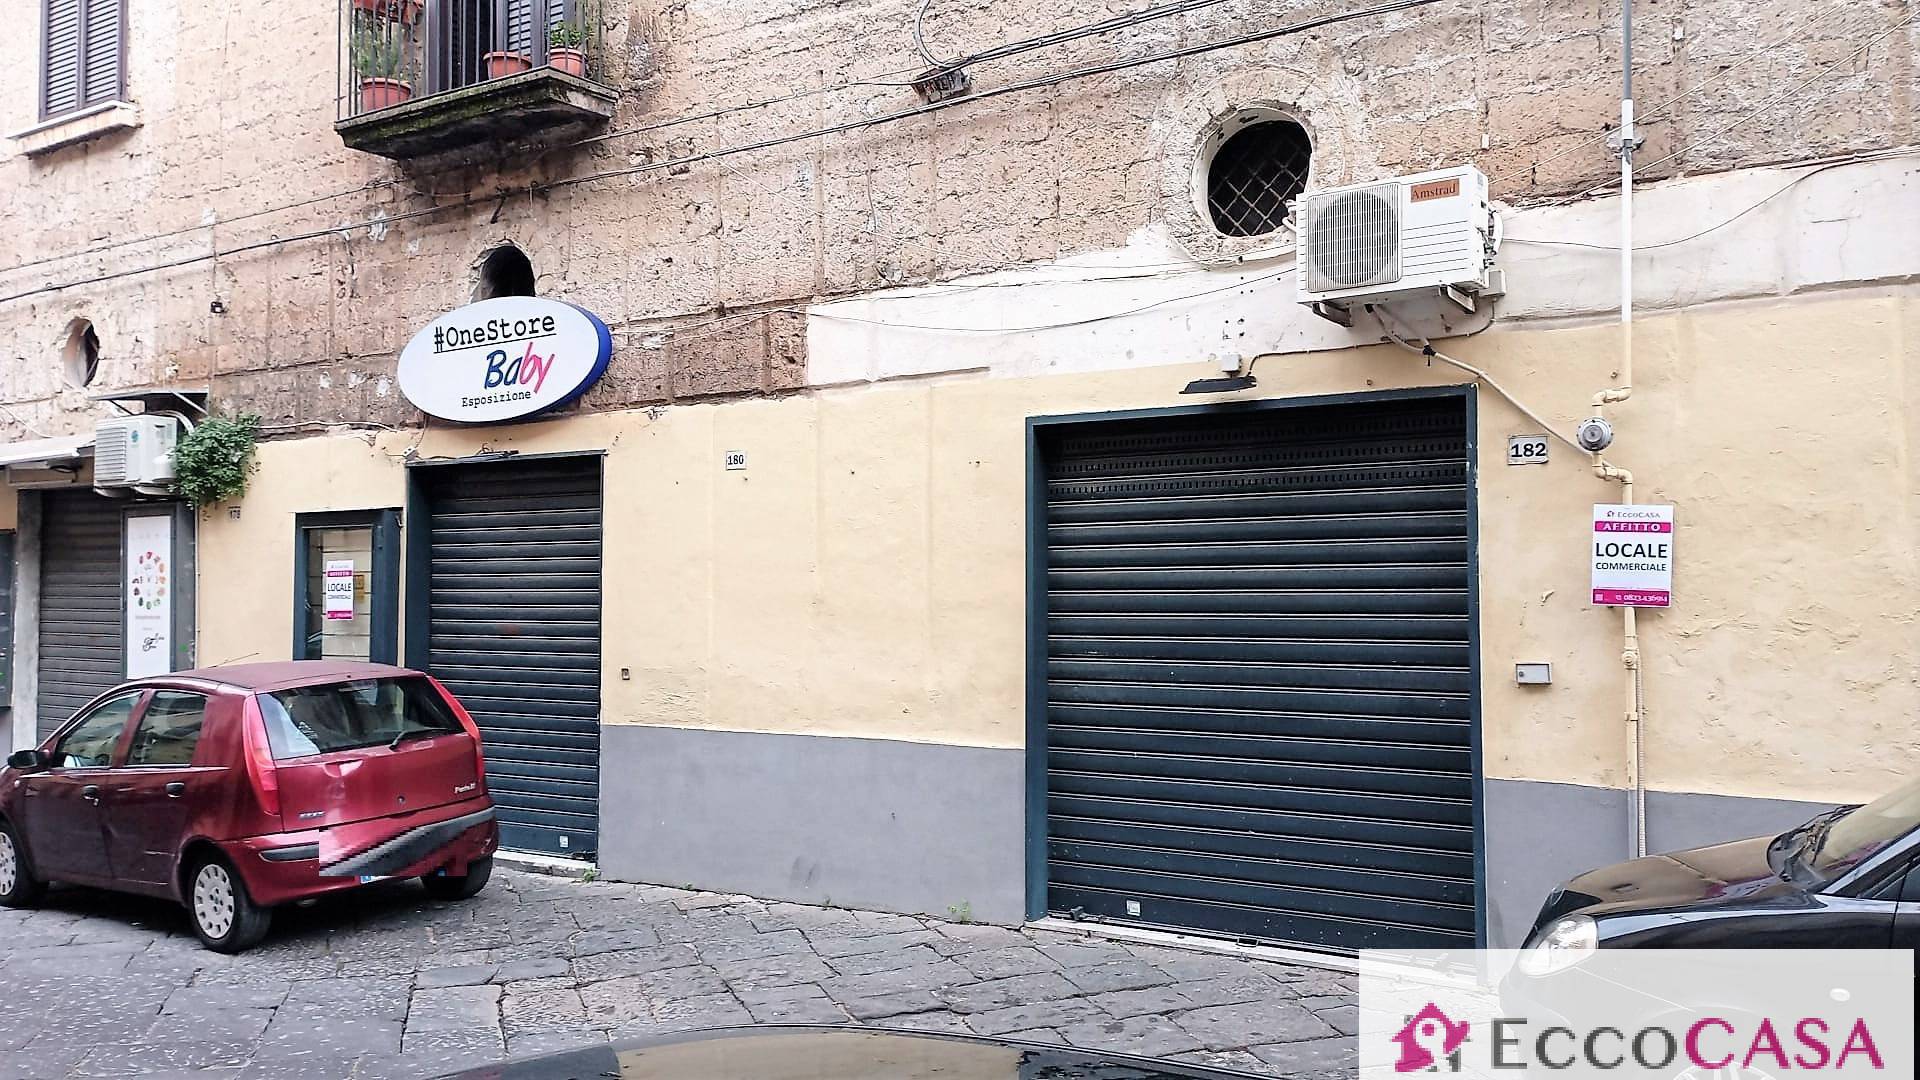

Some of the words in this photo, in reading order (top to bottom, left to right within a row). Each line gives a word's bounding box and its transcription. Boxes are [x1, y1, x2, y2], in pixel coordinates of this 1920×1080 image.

[1413, 183, 1456, 199] Amstrad
[433, 315, 556, 352] #OneStore
[484, 342, 555, 393] Baby
[461, 391, 532, 408] Esposizione
[1511, 442, 1546, 457] 182
[727, 454, 744, 465] 180
[1603, 523, 1661, 532] AFFITTO
[1595, 542, 1668, 558] LOCALE
[1595, 562, 1667, 571] COMMERCIALE
[327, 583, 352, 592] LOCALE
